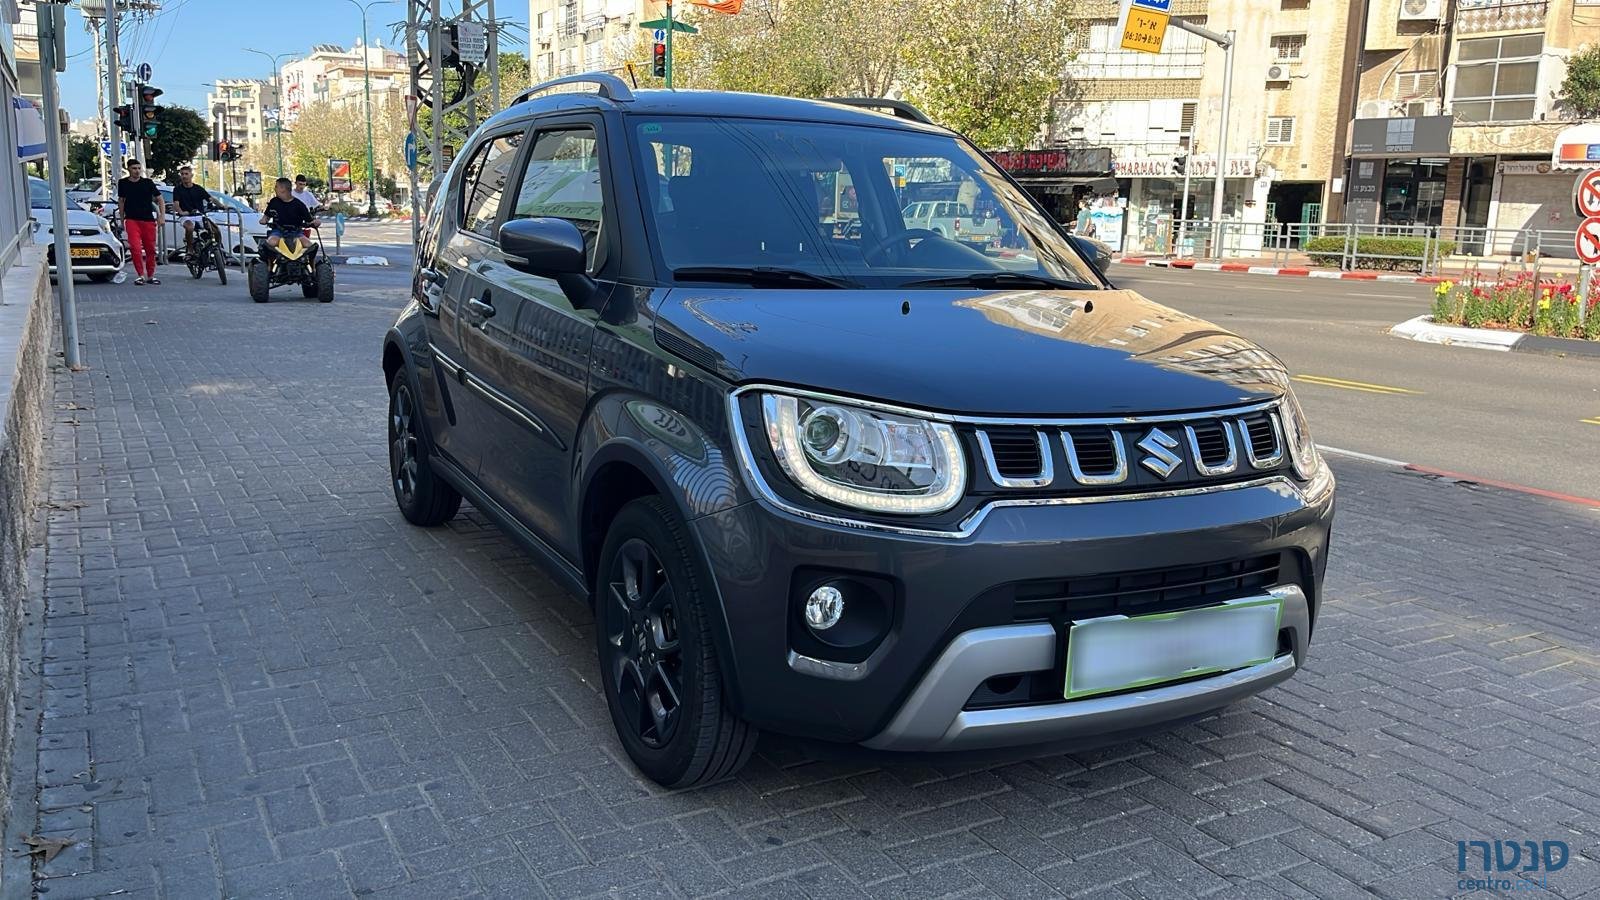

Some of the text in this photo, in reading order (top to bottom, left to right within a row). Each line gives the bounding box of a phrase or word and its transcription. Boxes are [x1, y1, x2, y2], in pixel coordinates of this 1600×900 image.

[1125, 31, 1142, 42] 06:30
[1115, 161, 1167, 176] PHARMACY
[1230, 160, 1252, 176] בית
